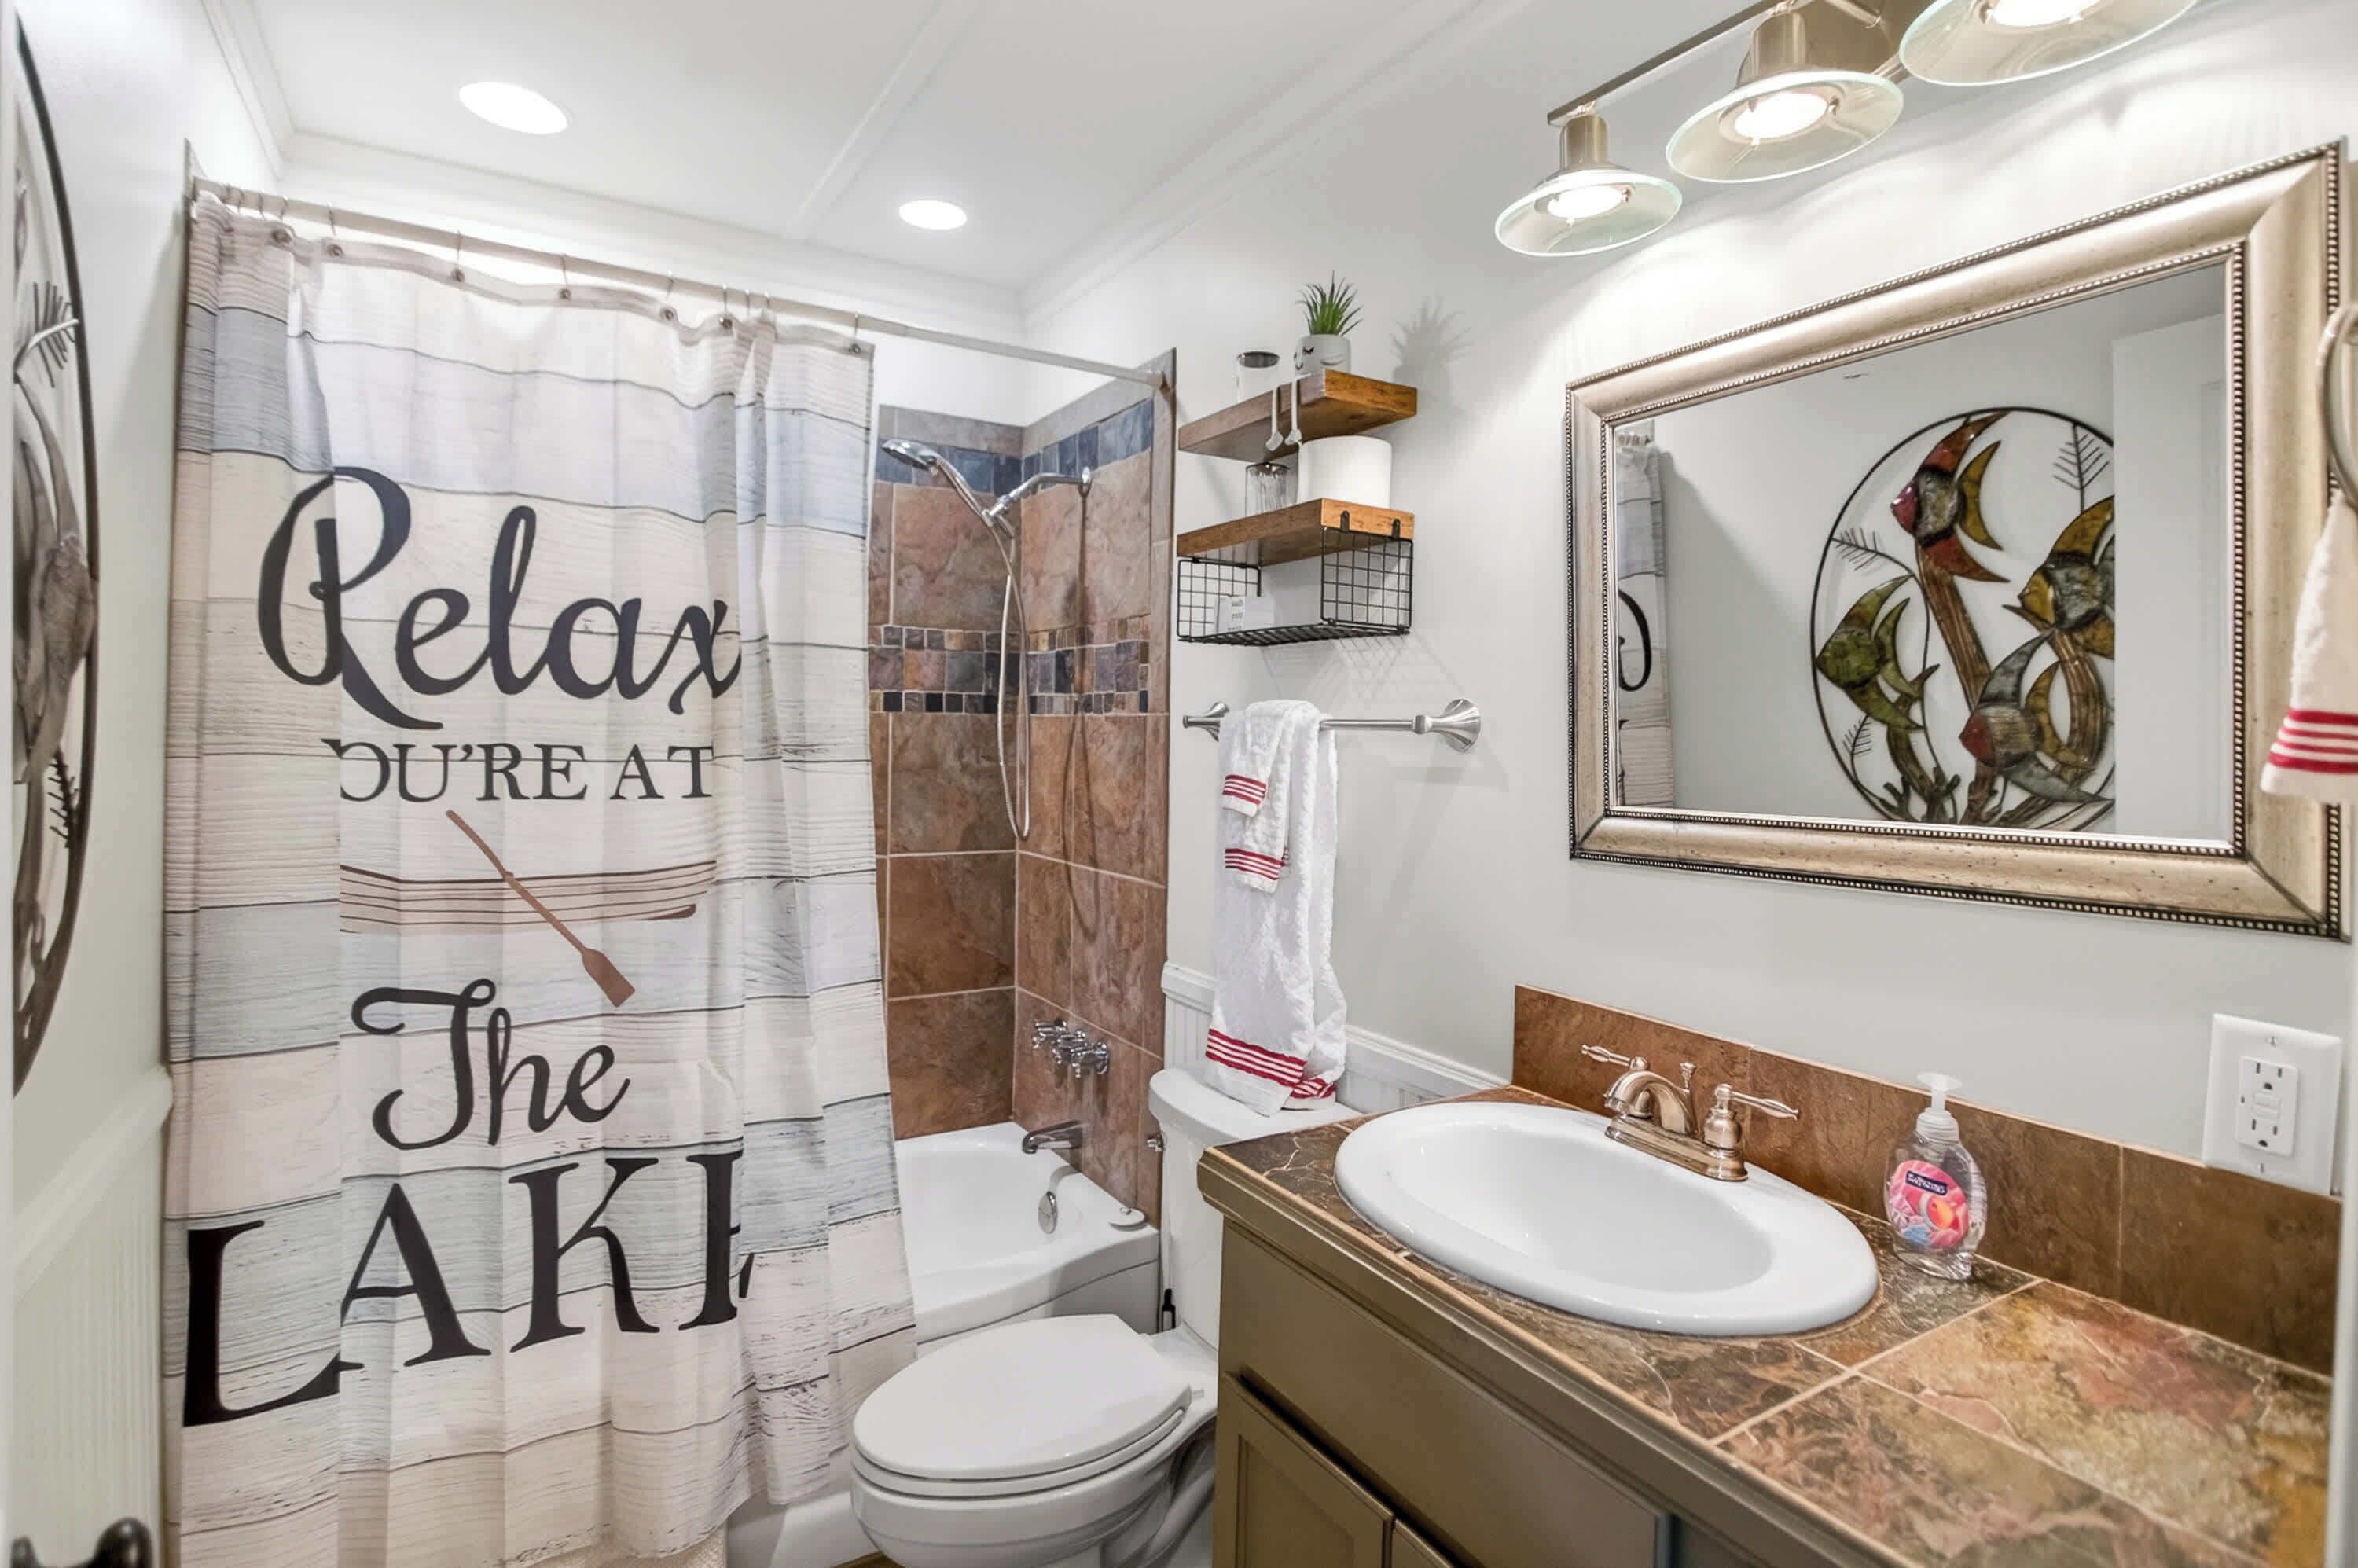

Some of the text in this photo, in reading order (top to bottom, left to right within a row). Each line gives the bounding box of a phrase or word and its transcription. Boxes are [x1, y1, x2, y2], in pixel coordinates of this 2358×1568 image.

[258, 466, 742, 729] Relax
[609, 744, 714, 800] AT
[351, 979, 631, 1151] The
